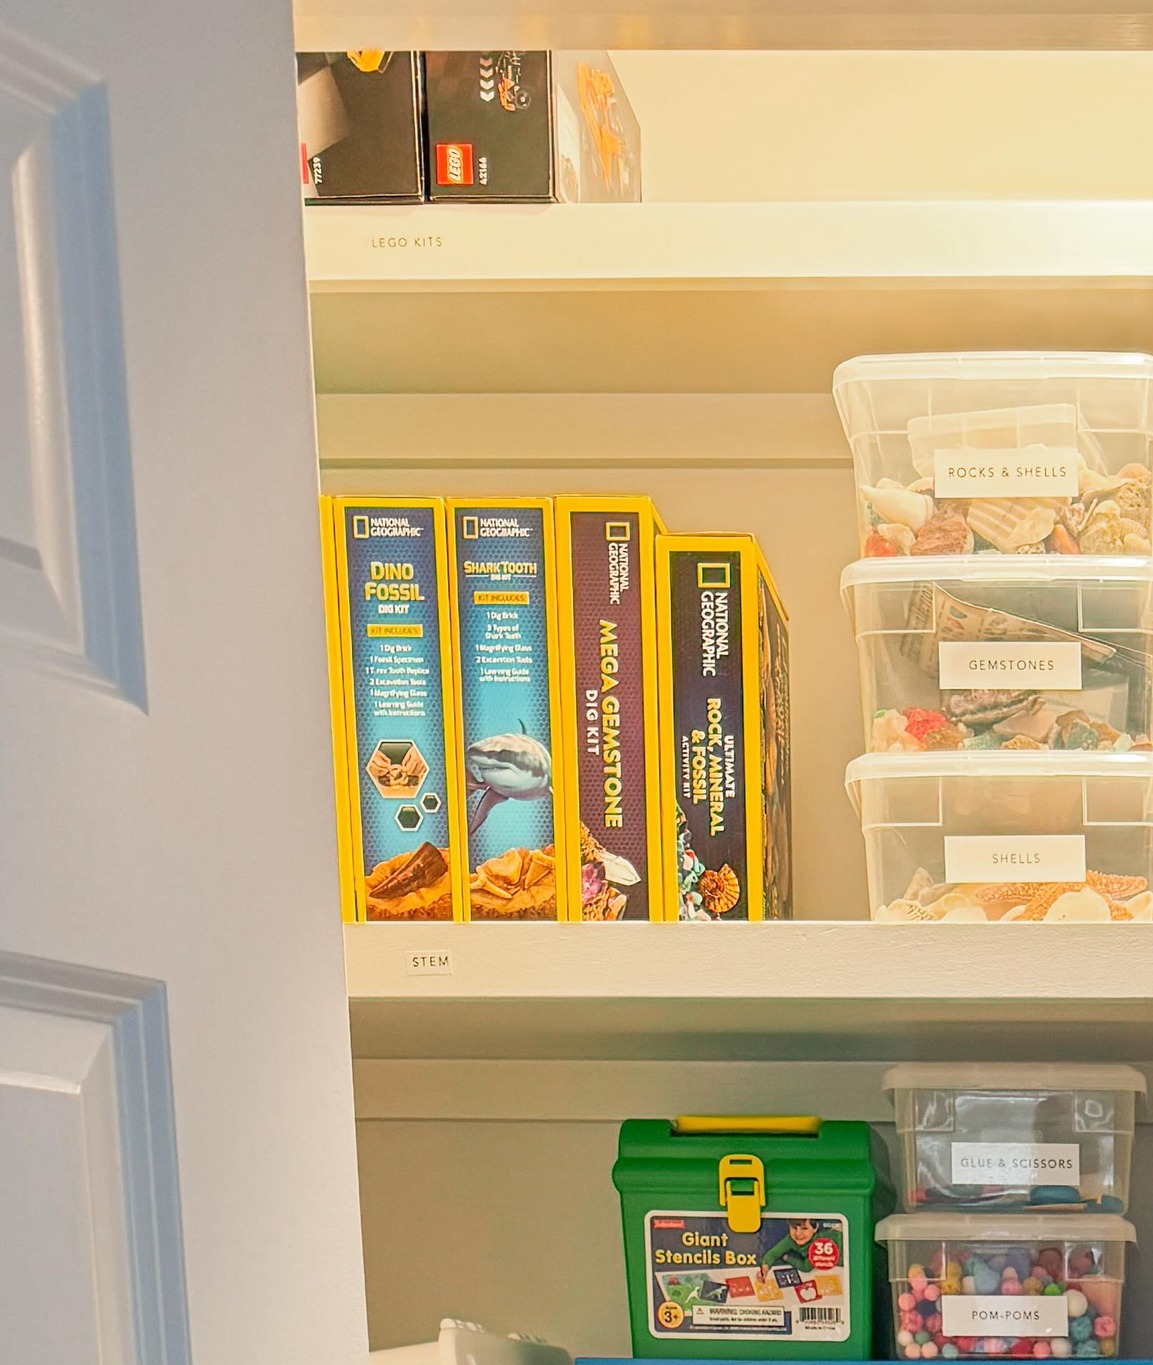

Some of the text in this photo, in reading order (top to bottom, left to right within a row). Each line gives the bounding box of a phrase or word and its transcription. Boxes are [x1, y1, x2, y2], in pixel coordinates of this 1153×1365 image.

[372, 237, 442, 248] LEGO KITS
[948, 465, 1067, 478] ROCKS & SHELLS
[370, 562, 414, 581] DINO
[463, 561, 537, 574] SHARK TOOTH
[618, 543, 630, 592] NATIONAL
[364, 582, 425, 602] FOSSIL
[715, 591, 729, 659] NATIONAL
[701, 590, 716, 677] GEOGRAPHIC
[968, 659, 1055, 671] GEMSTONES
[585, 689, 600, 756] DIG KIT
[599, 619, 624, 829] MEGA GEMSTONE
[691, 729, 707, 804] & FOSSIL
[706, 697, 727, 837] ROCK, MINERAL
[724, 734, 736, 798] ULTIMATE
[992, 853, 1041, 864] SHELLS
[412, 956, 449, 968] STEM
[960, 1157, 1073, 1169] GLUE & SCISSORS
[682, 1232, 728, 1247] Giant
[815, 1242, 833, 1255] 36
[655, 1249, 757, 1265] Stencils Box
[971, 1310, 1040, 1320] POM-POMS
